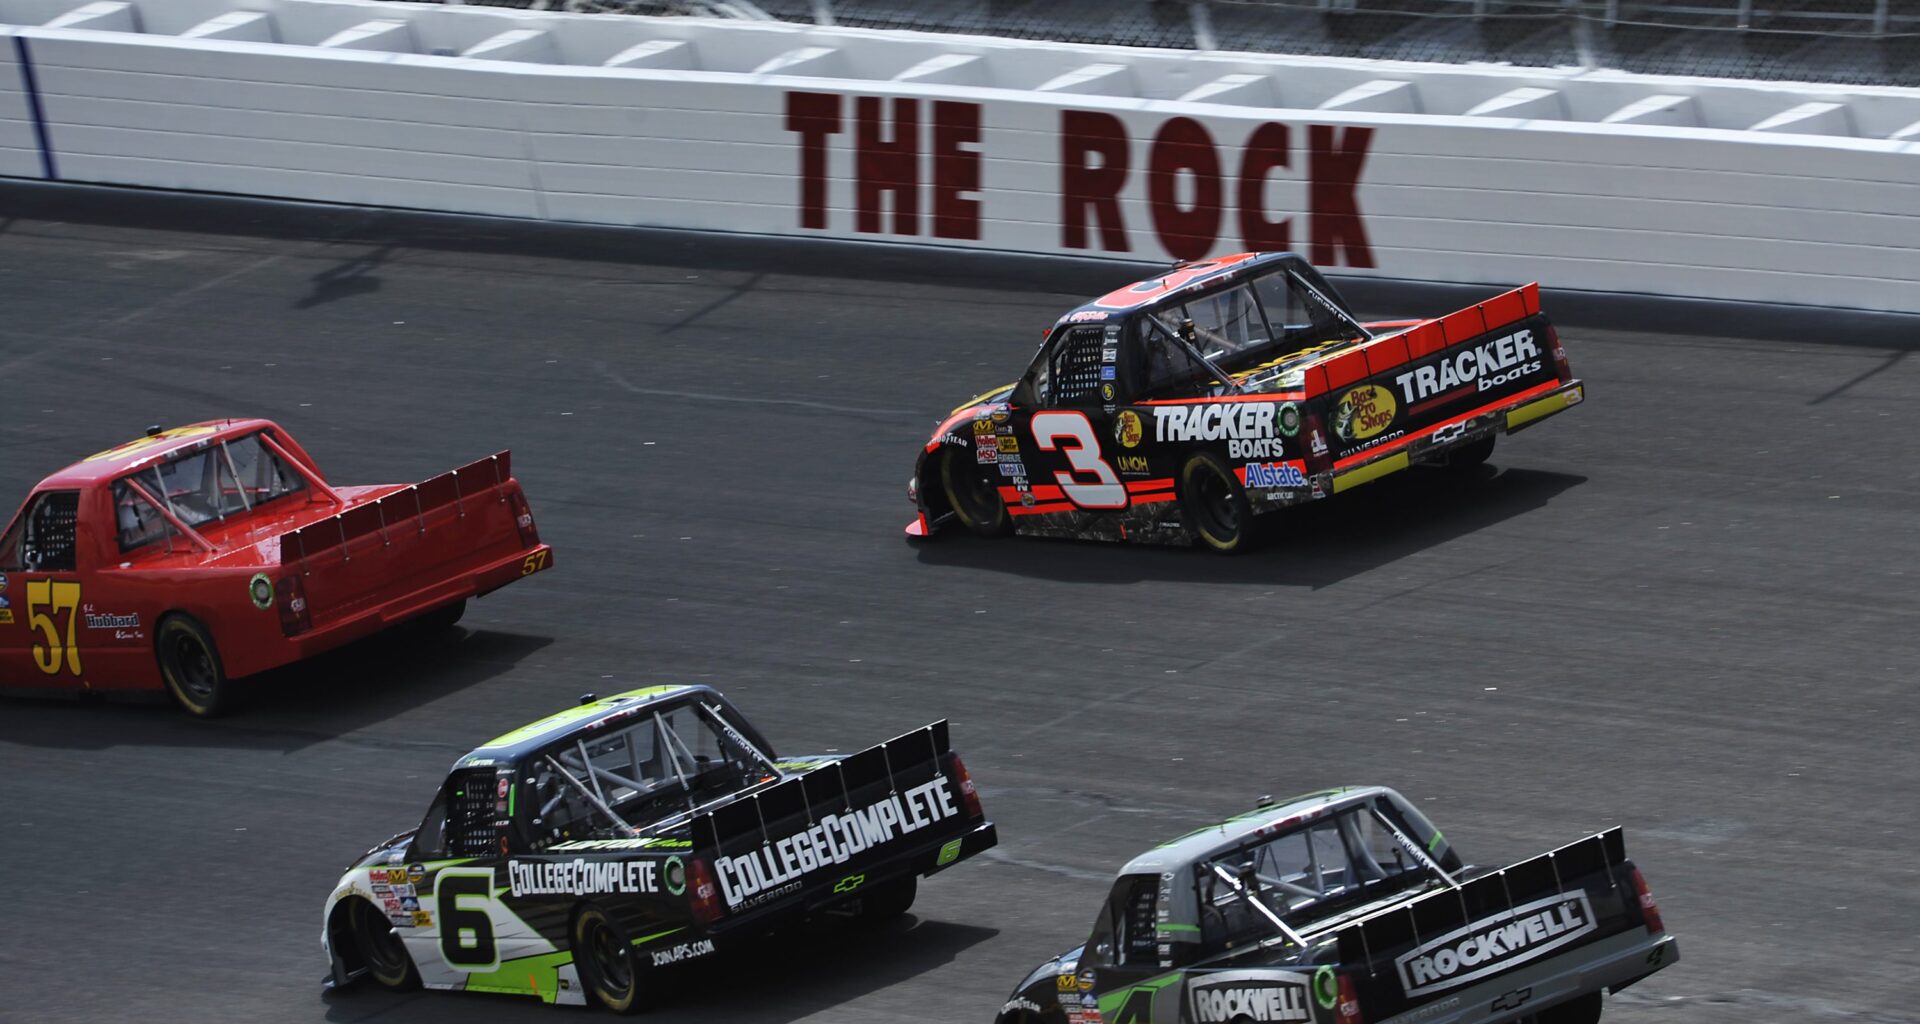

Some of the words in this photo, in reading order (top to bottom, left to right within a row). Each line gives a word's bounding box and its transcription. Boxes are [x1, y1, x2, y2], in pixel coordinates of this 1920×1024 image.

[783, 91, 983, 241] THE
[1060, 109, 1379, 269] ROCK
[1396, 329, 1538, 404] TRACKER
[1478, 360, 1541, 392] boats
[1351, 387, 1378, 407] Bass
[1357, 401, 1377, 417] Pro
[1563, 388, 1583, 406] 3
[1153, 402, 1276, 442] TRACKER
[1361, 409, 1393, 432] Shops
[978, 449, 996, 459] MSD
[1228, 438, 1283, 458] BOATS
[1340, 429, 1405, 457] SILVERADO
[1030, 410, 1128, 509] 3
[1117, 456, 1149, 472] UNOH
[1245, 463, 1302, 488] Allstate
[521, 550, 548, 576] 57
[26, 577, 82, 677] 57
[85, 612, 141, 629] Hubbard
[936, 838, 963, 866] 6
[730, 881, 803, 914] SILVERADO
[436, 868, 500, 971] 6
[1410, 902, 1583, 986] ROCKWELL
[1197, 985, 1308, 1023] ROCKWELL
